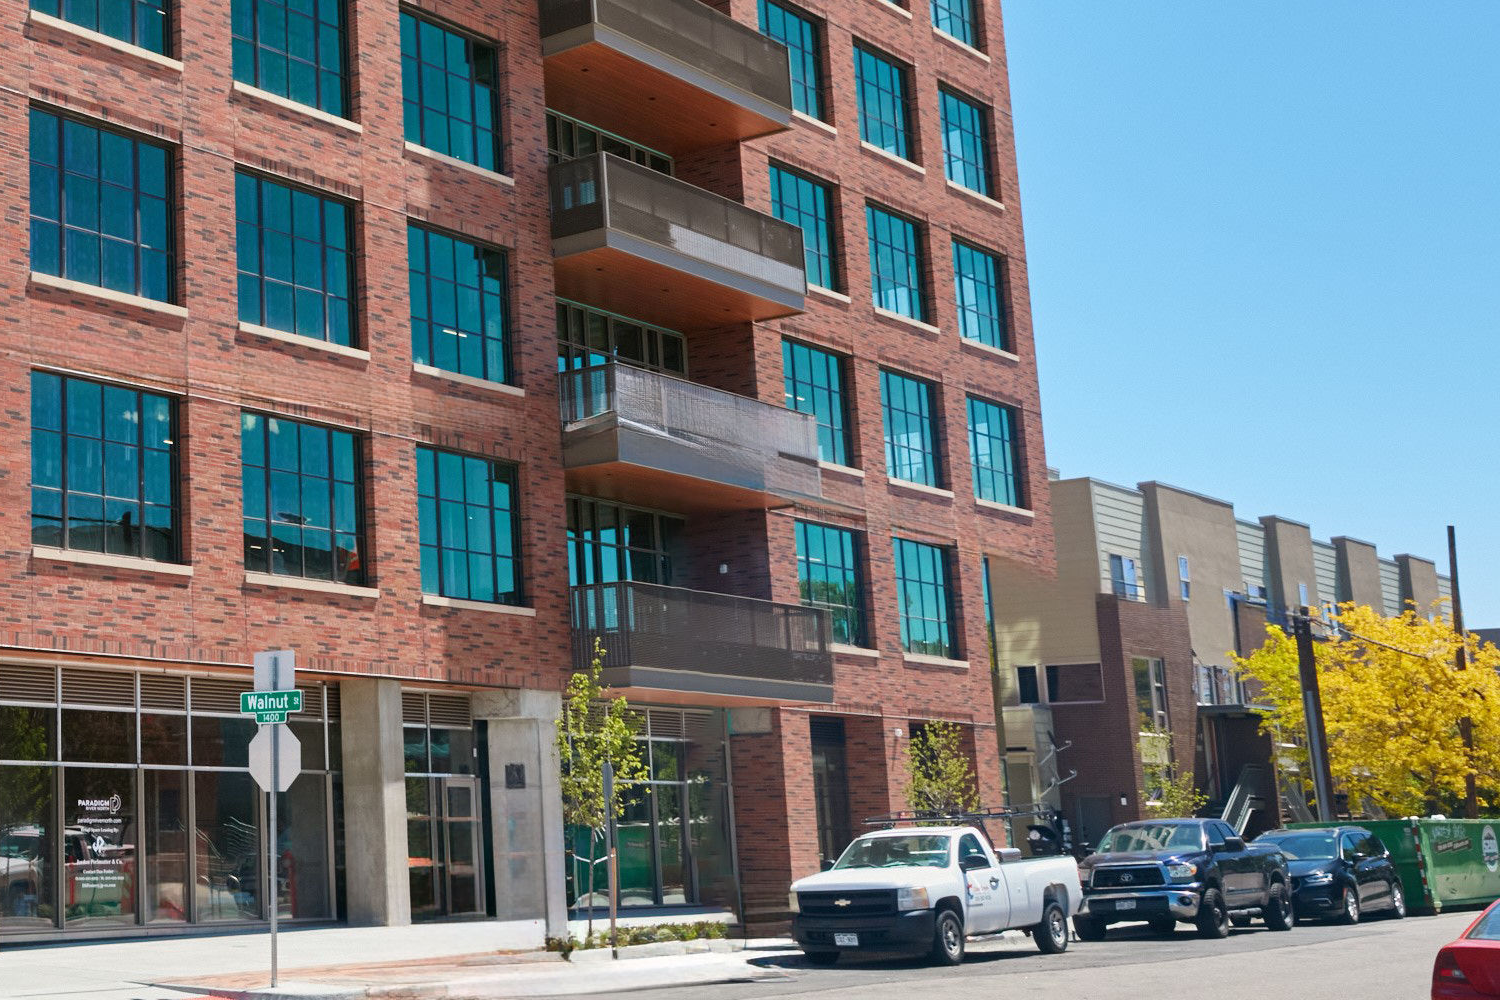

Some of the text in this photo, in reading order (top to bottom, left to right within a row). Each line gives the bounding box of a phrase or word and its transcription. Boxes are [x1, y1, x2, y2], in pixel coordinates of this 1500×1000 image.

[247, 694, 299, 709] Walnut St
[263, 713, 279, 721] 1400
